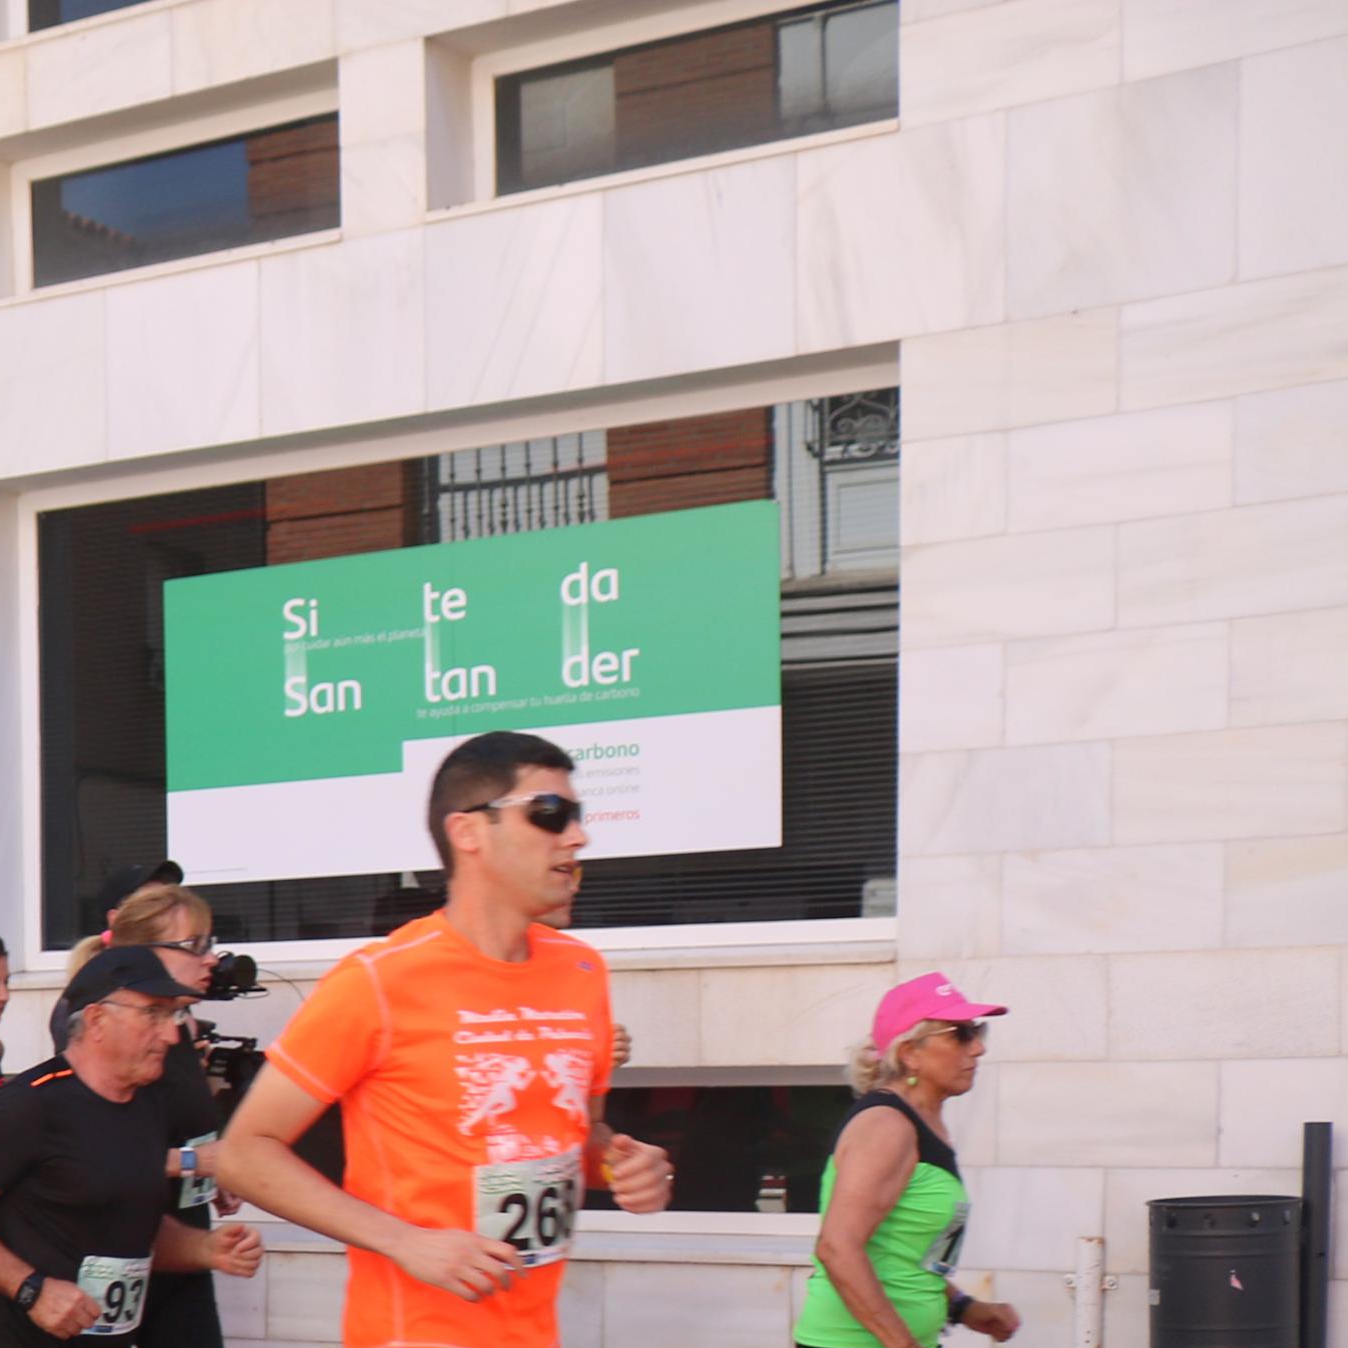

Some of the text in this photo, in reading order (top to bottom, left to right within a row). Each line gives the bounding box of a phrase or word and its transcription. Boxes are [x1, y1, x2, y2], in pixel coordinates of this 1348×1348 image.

[283, 561, 619, 640] Si te da
[284, 645, 640, 718] San tan der
